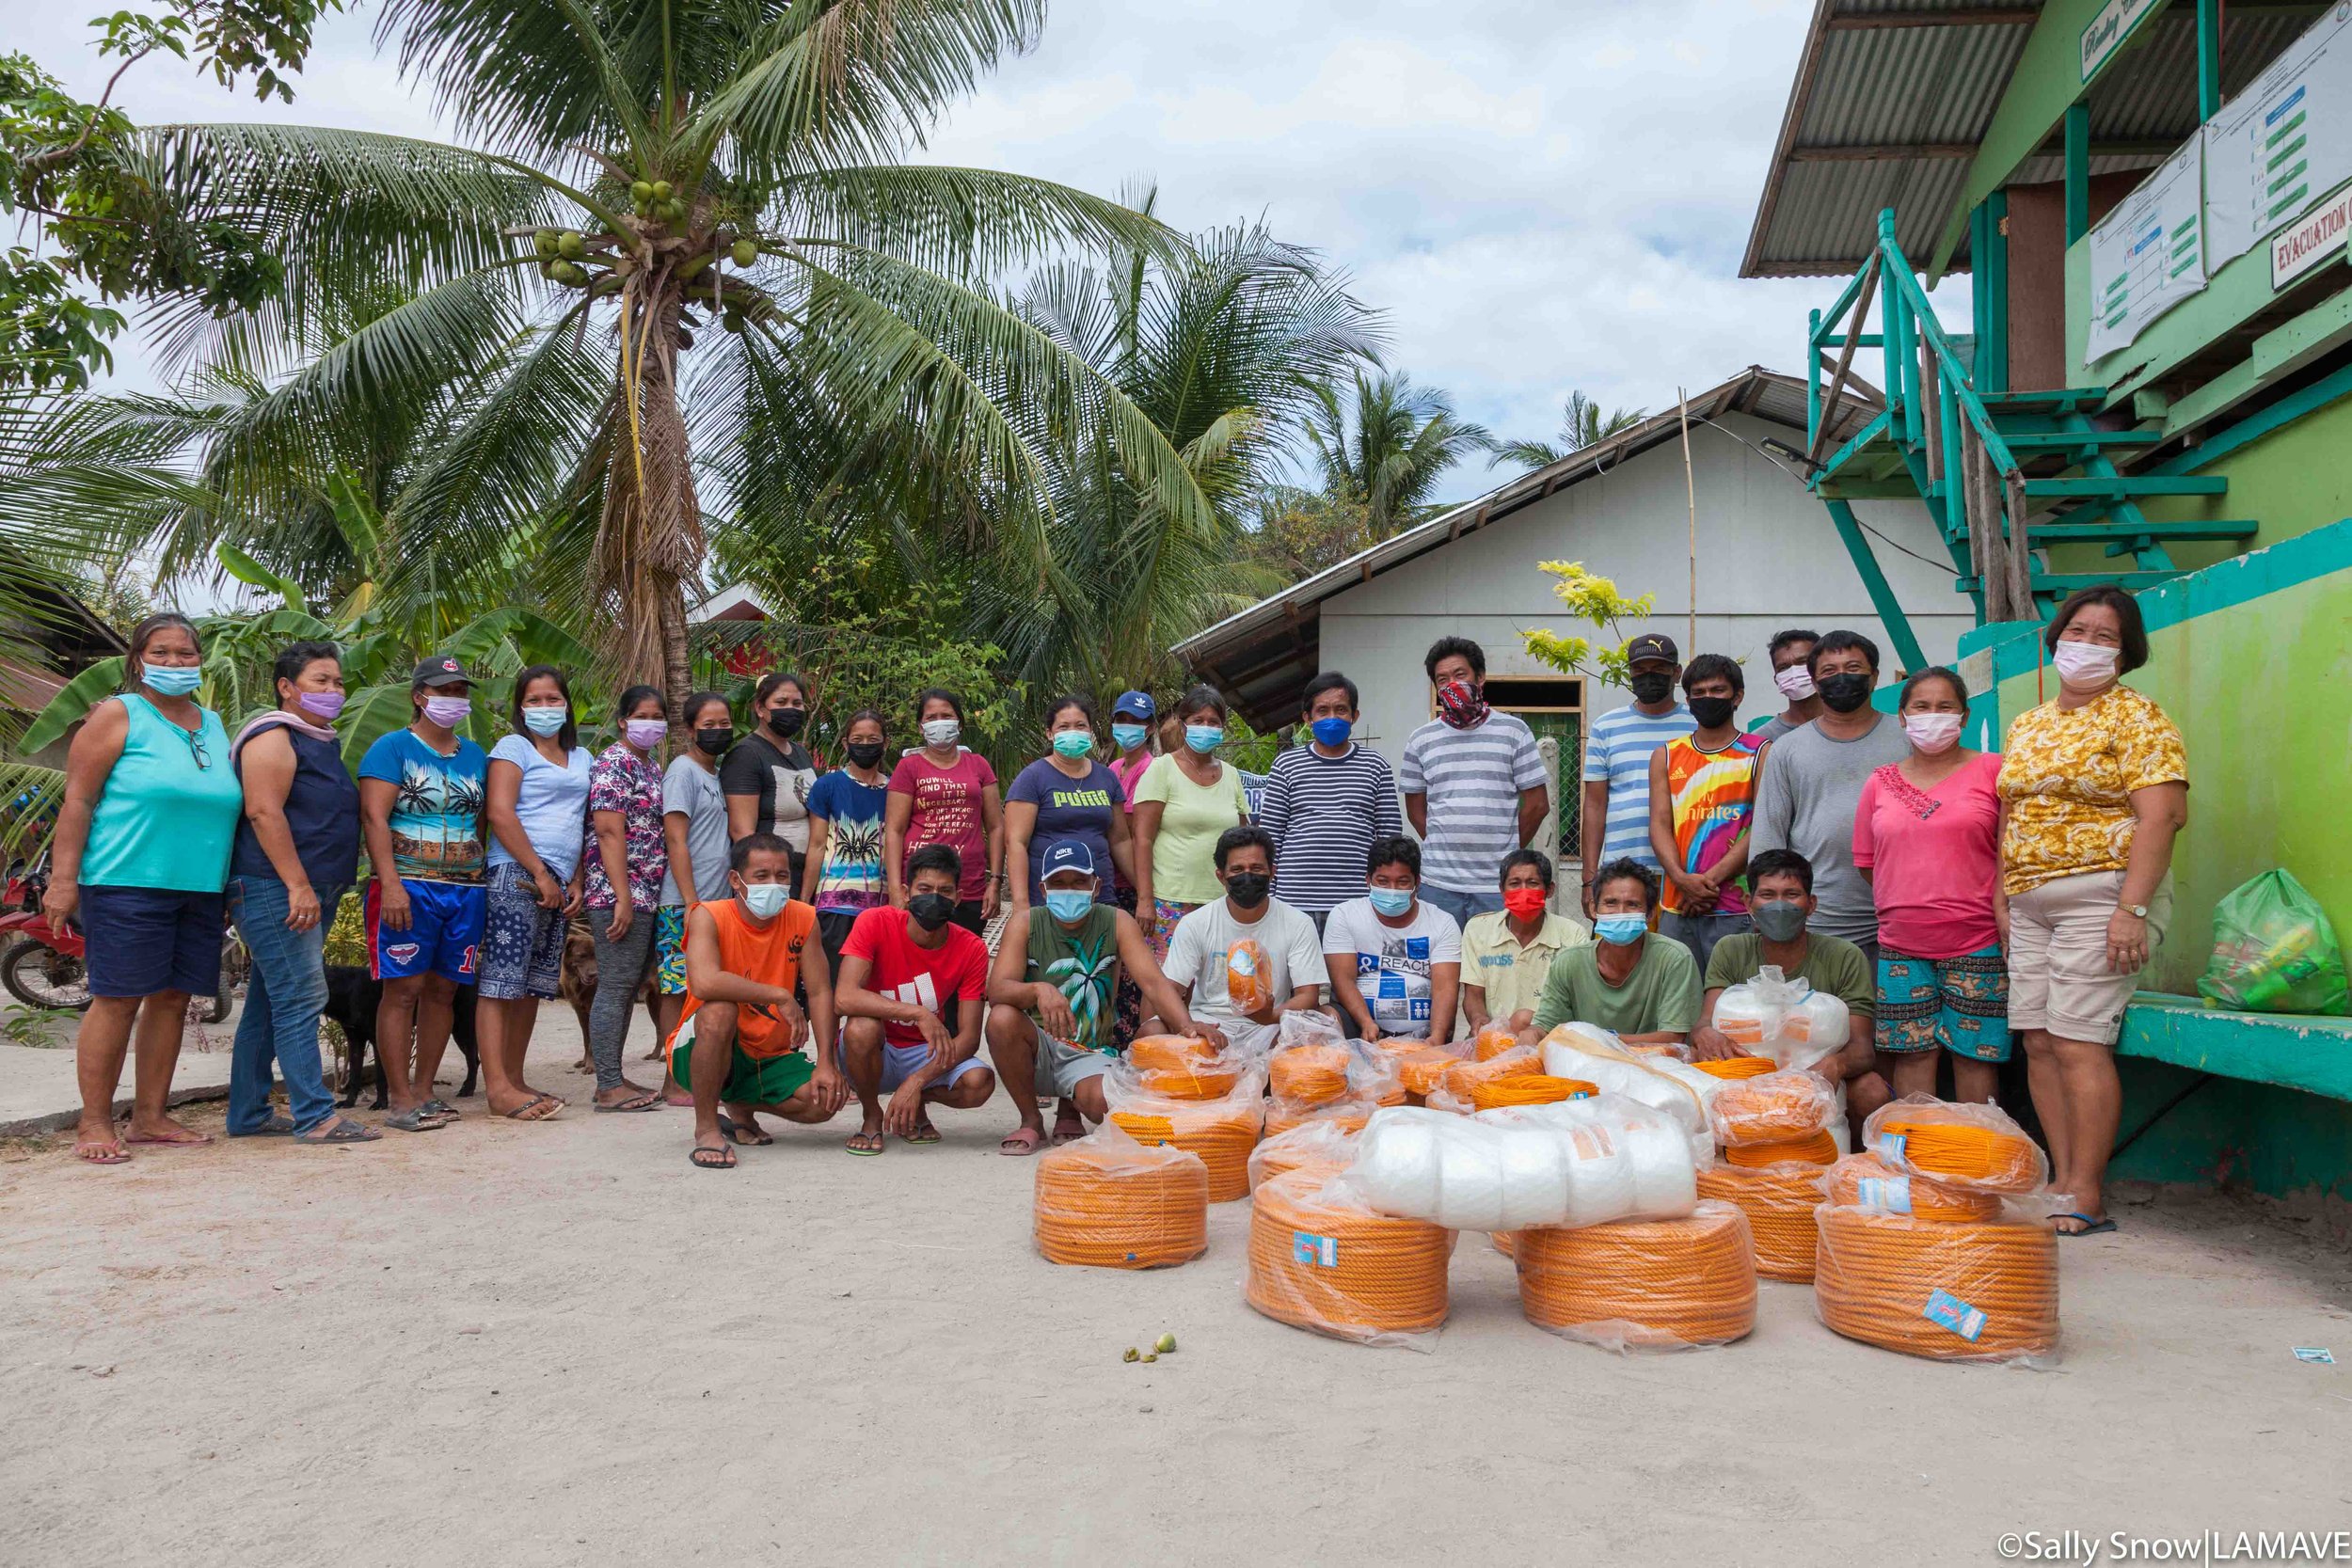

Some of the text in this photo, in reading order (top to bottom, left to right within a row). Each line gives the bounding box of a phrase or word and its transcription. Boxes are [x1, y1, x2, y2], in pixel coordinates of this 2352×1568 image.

[2279, 201, 2345, 271] EVACUATION
[919, 784, 941, 794] FIND
[1054, 790, 1110, 808] PUMA
[1056, 847, 1073, 856] NIKE
